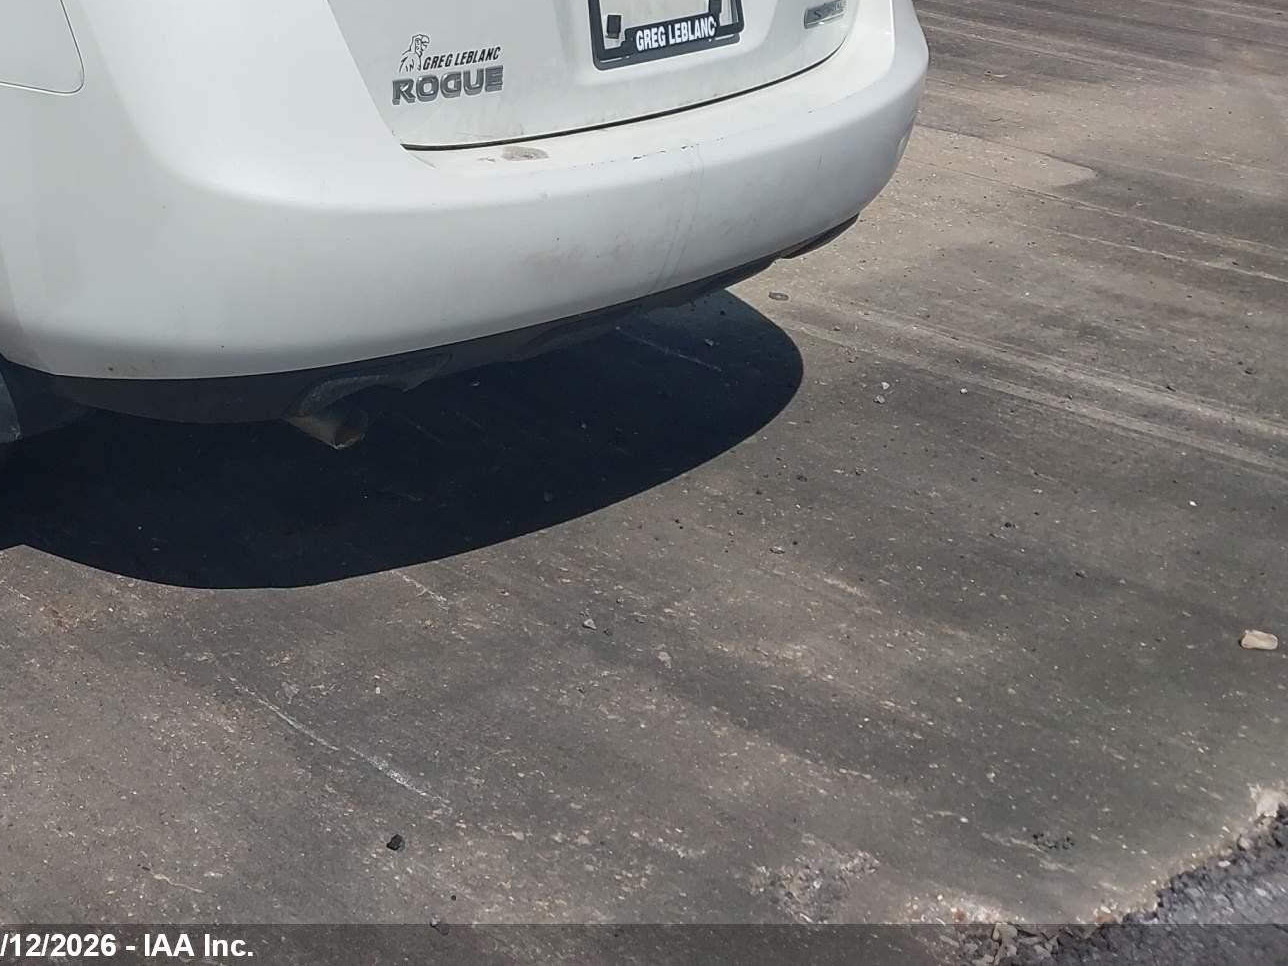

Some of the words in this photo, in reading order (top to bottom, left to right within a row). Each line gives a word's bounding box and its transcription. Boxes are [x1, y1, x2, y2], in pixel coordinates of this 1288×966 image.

[636, 25, 666, 52] GREG
[668, 16, 717, 45] LEBLANC
[422, 54, 453, 70] GREG
[454, 46, 501, 66] LEBLANC
[392, 65, 503, 105] ROGUE
